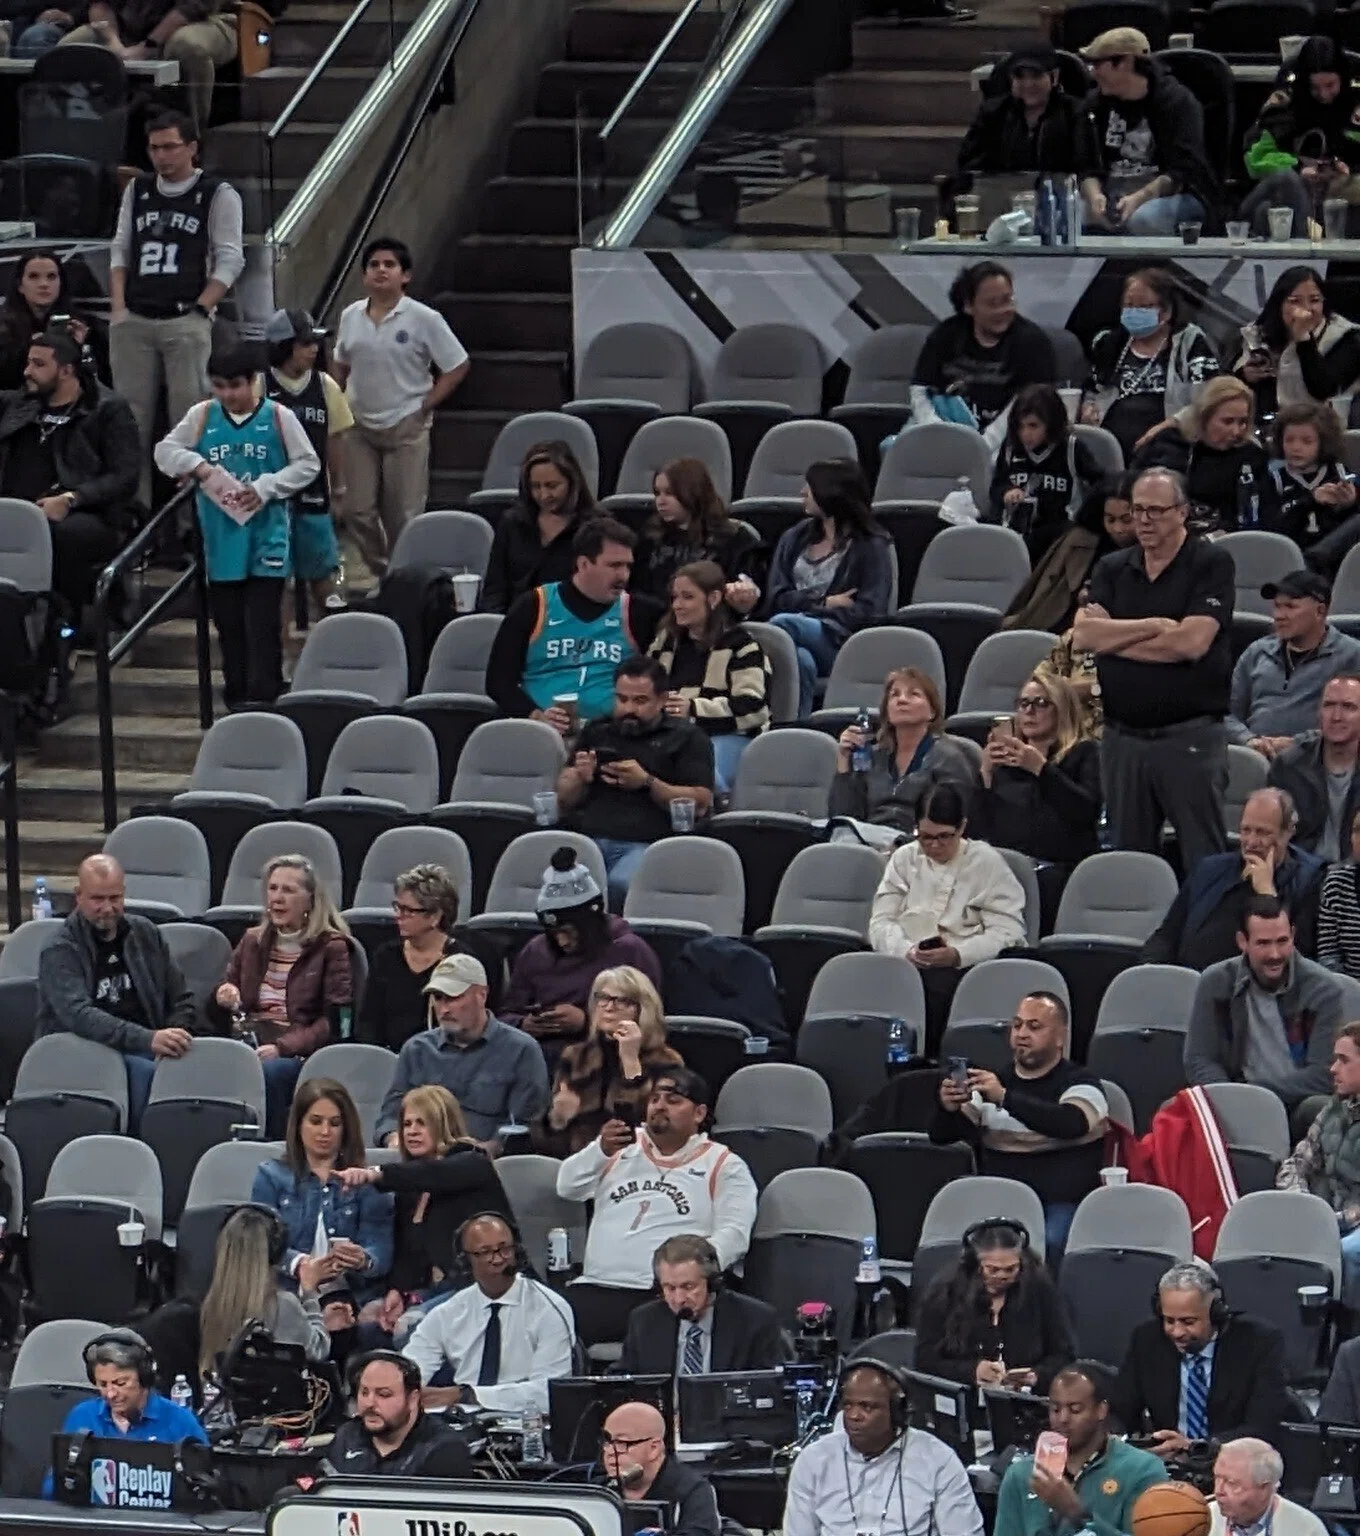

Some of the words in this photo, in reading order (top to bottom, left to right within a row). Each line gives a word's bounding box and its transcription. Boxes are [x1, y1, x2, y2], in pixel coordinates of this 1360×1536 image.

[136, 212, 200, 236] SPURS
[139, 242, 179, 276] 21
[209, 443, 267, 462] SPURS
[546, 638, 623, 664] SPURS
[609, 1181, 638, 1204] SAN
[641, 1179, 691, 1216] ANTONIO
[118, 1461, 172, 1499] Replay
